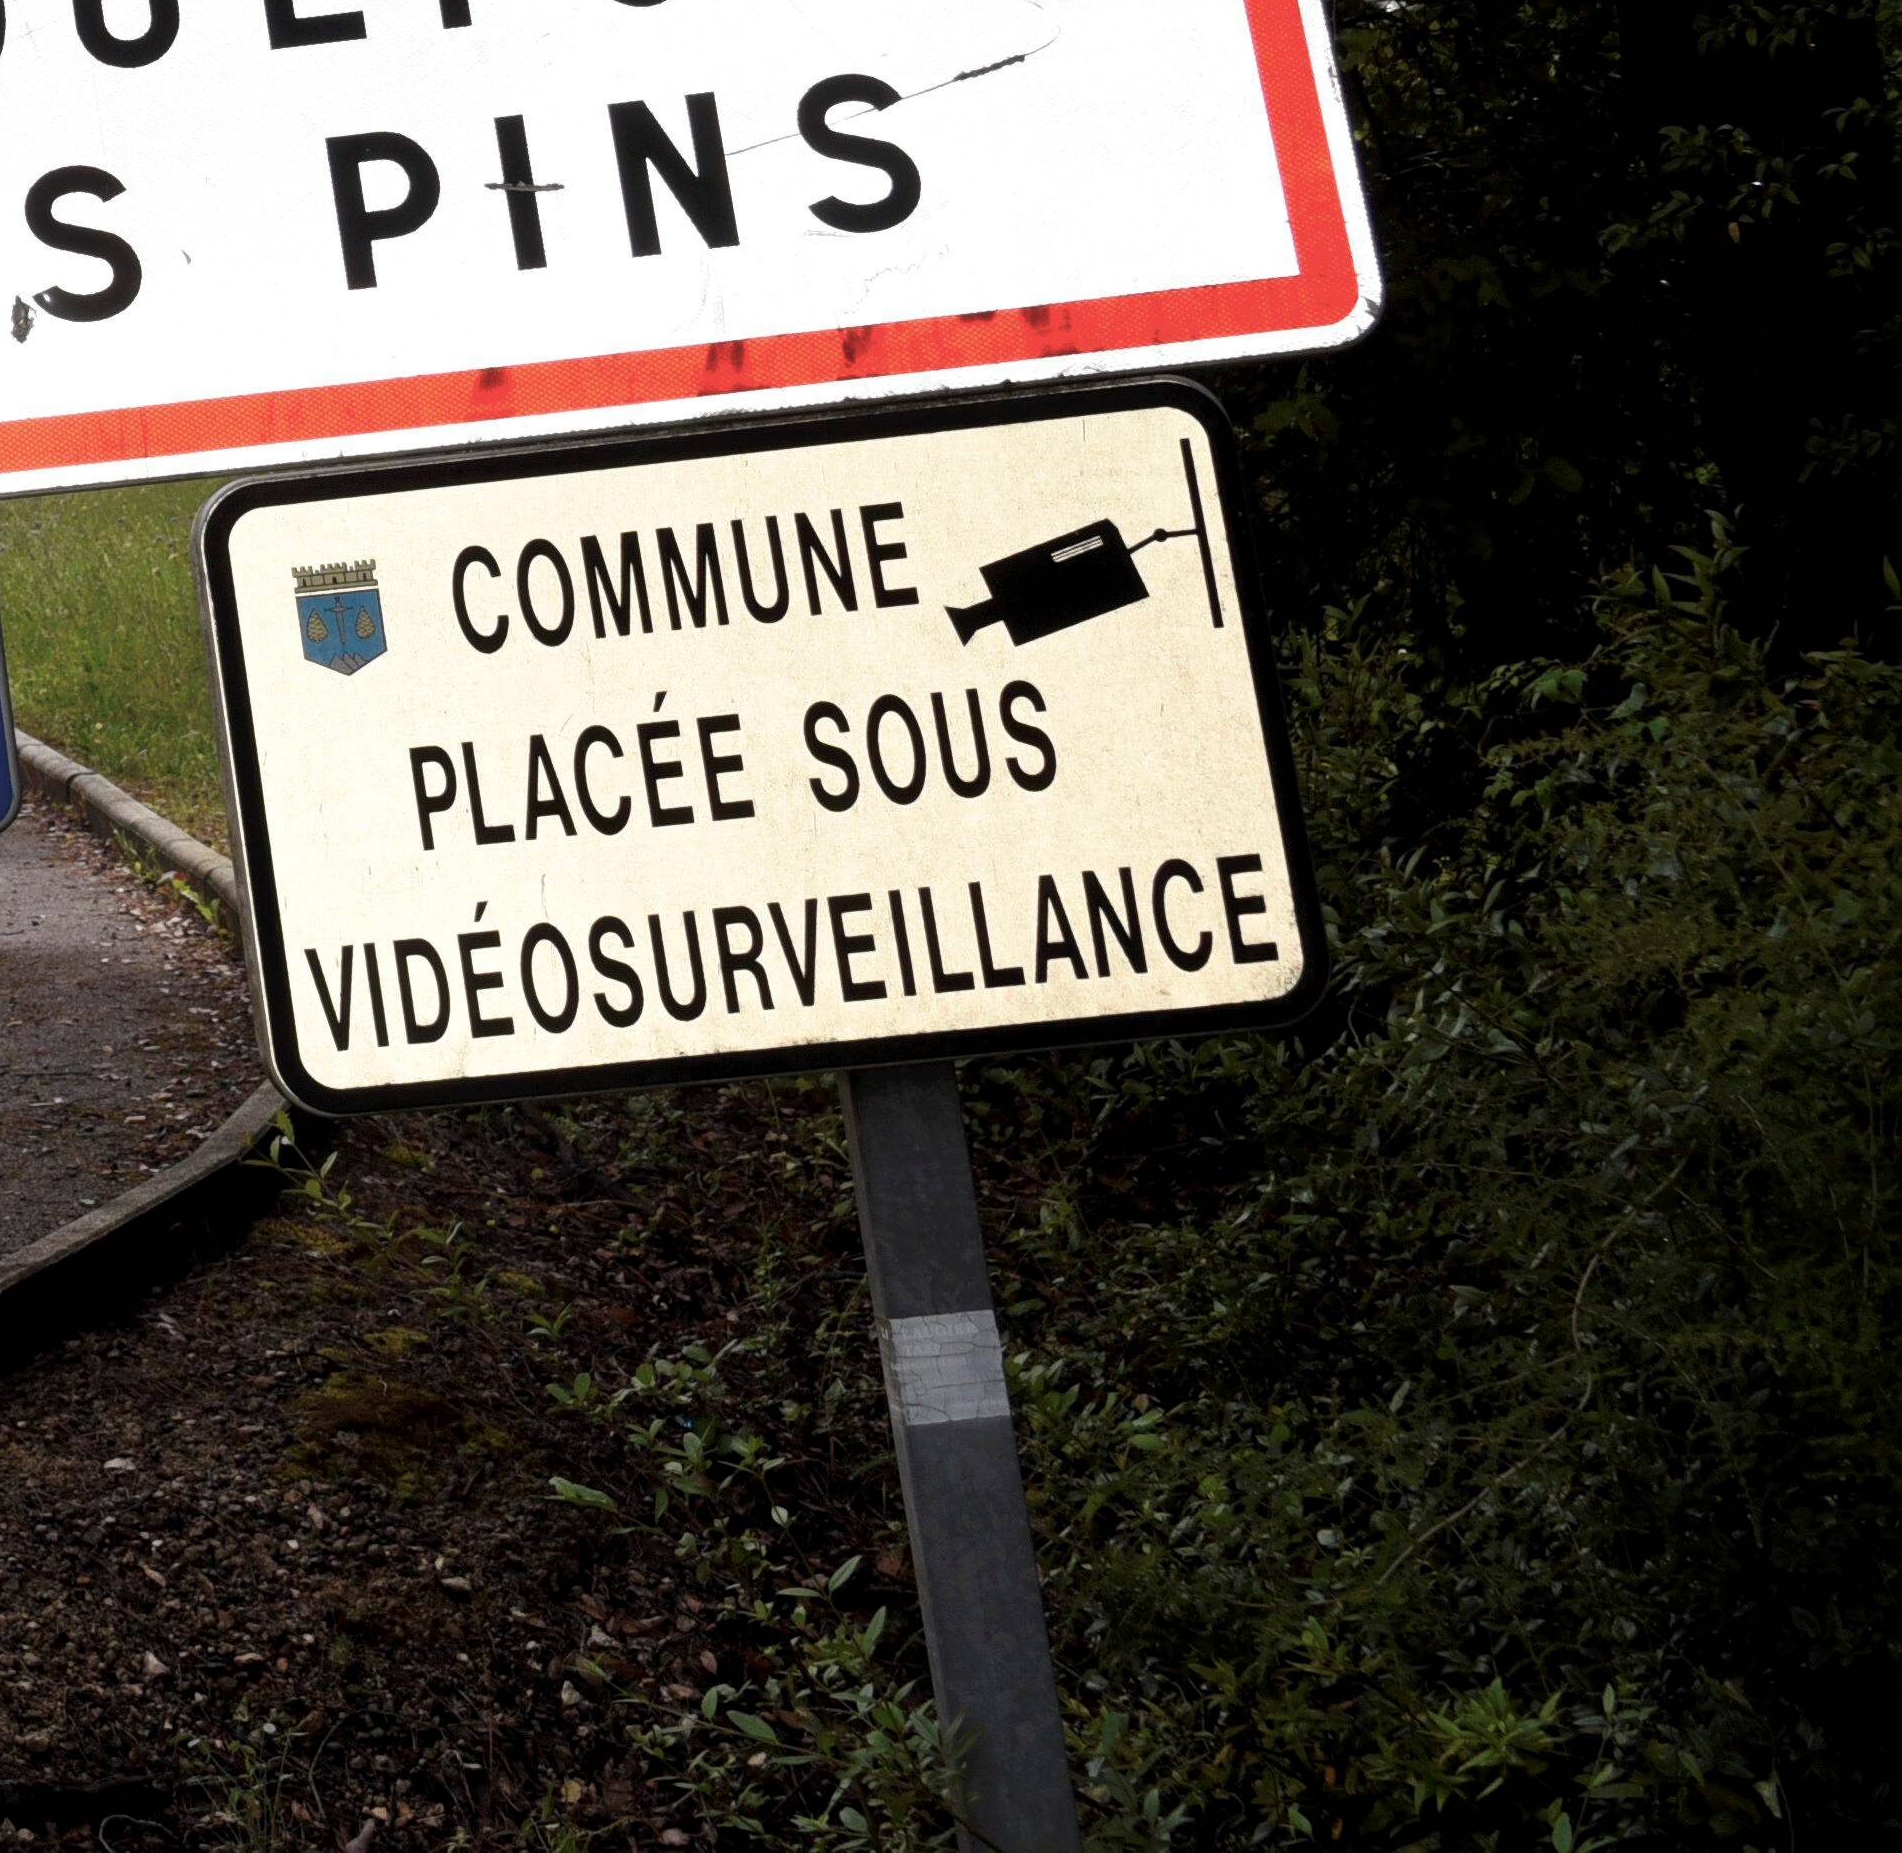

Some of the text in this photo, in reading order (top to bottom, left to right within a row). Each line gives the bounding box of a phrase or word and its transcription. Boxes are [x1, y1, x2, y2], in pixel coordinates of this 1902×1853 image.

[326, 74, 921, 289] PINS
[453, 502, 919, 654] COMMUNE
[410, 681, 1056, 850] PLACÉE SOUS
[305, 854, 1278, 1051] VIDÉOSURVEILLANCE
